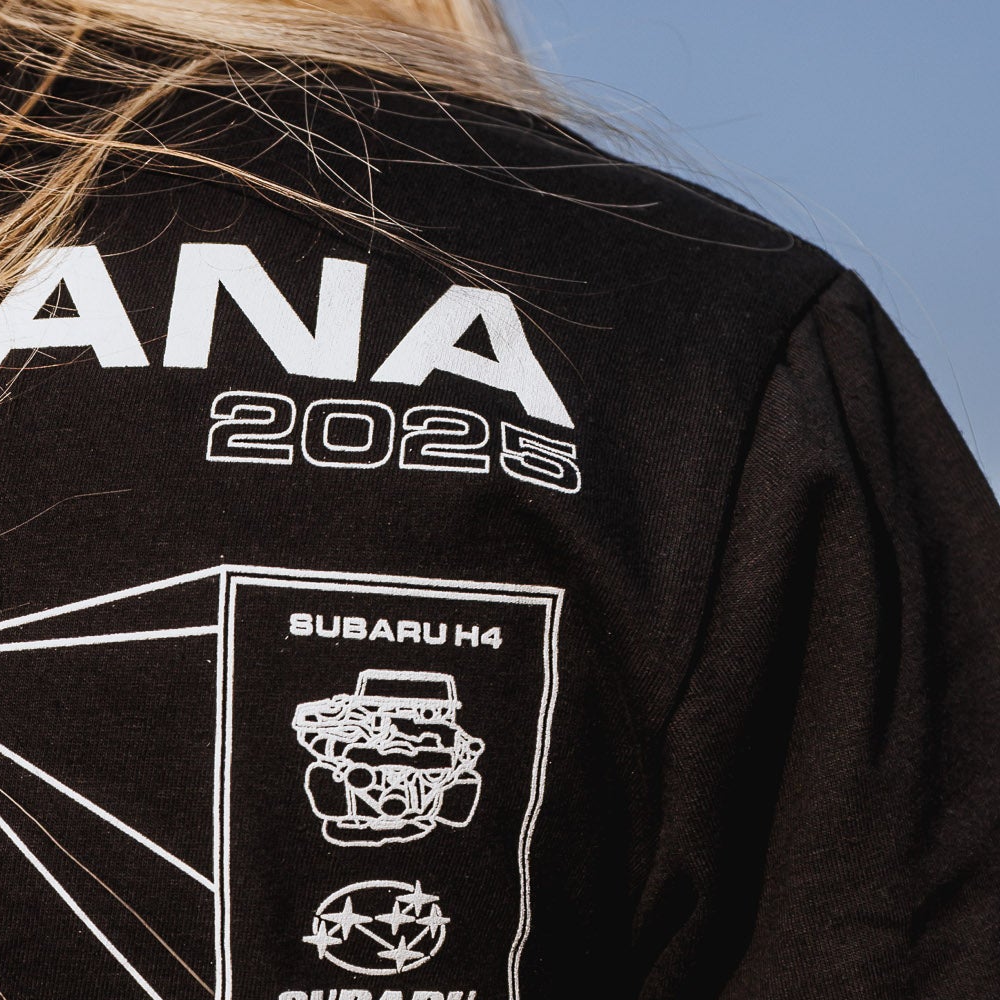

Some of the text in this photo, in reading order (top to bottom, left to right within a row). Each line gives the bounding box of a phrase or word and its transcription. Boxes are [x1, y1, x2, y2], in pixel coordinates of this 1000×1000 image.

[206, 390, 582, 495] 2025
[289, 613, 503, 650] SUBARU H4
